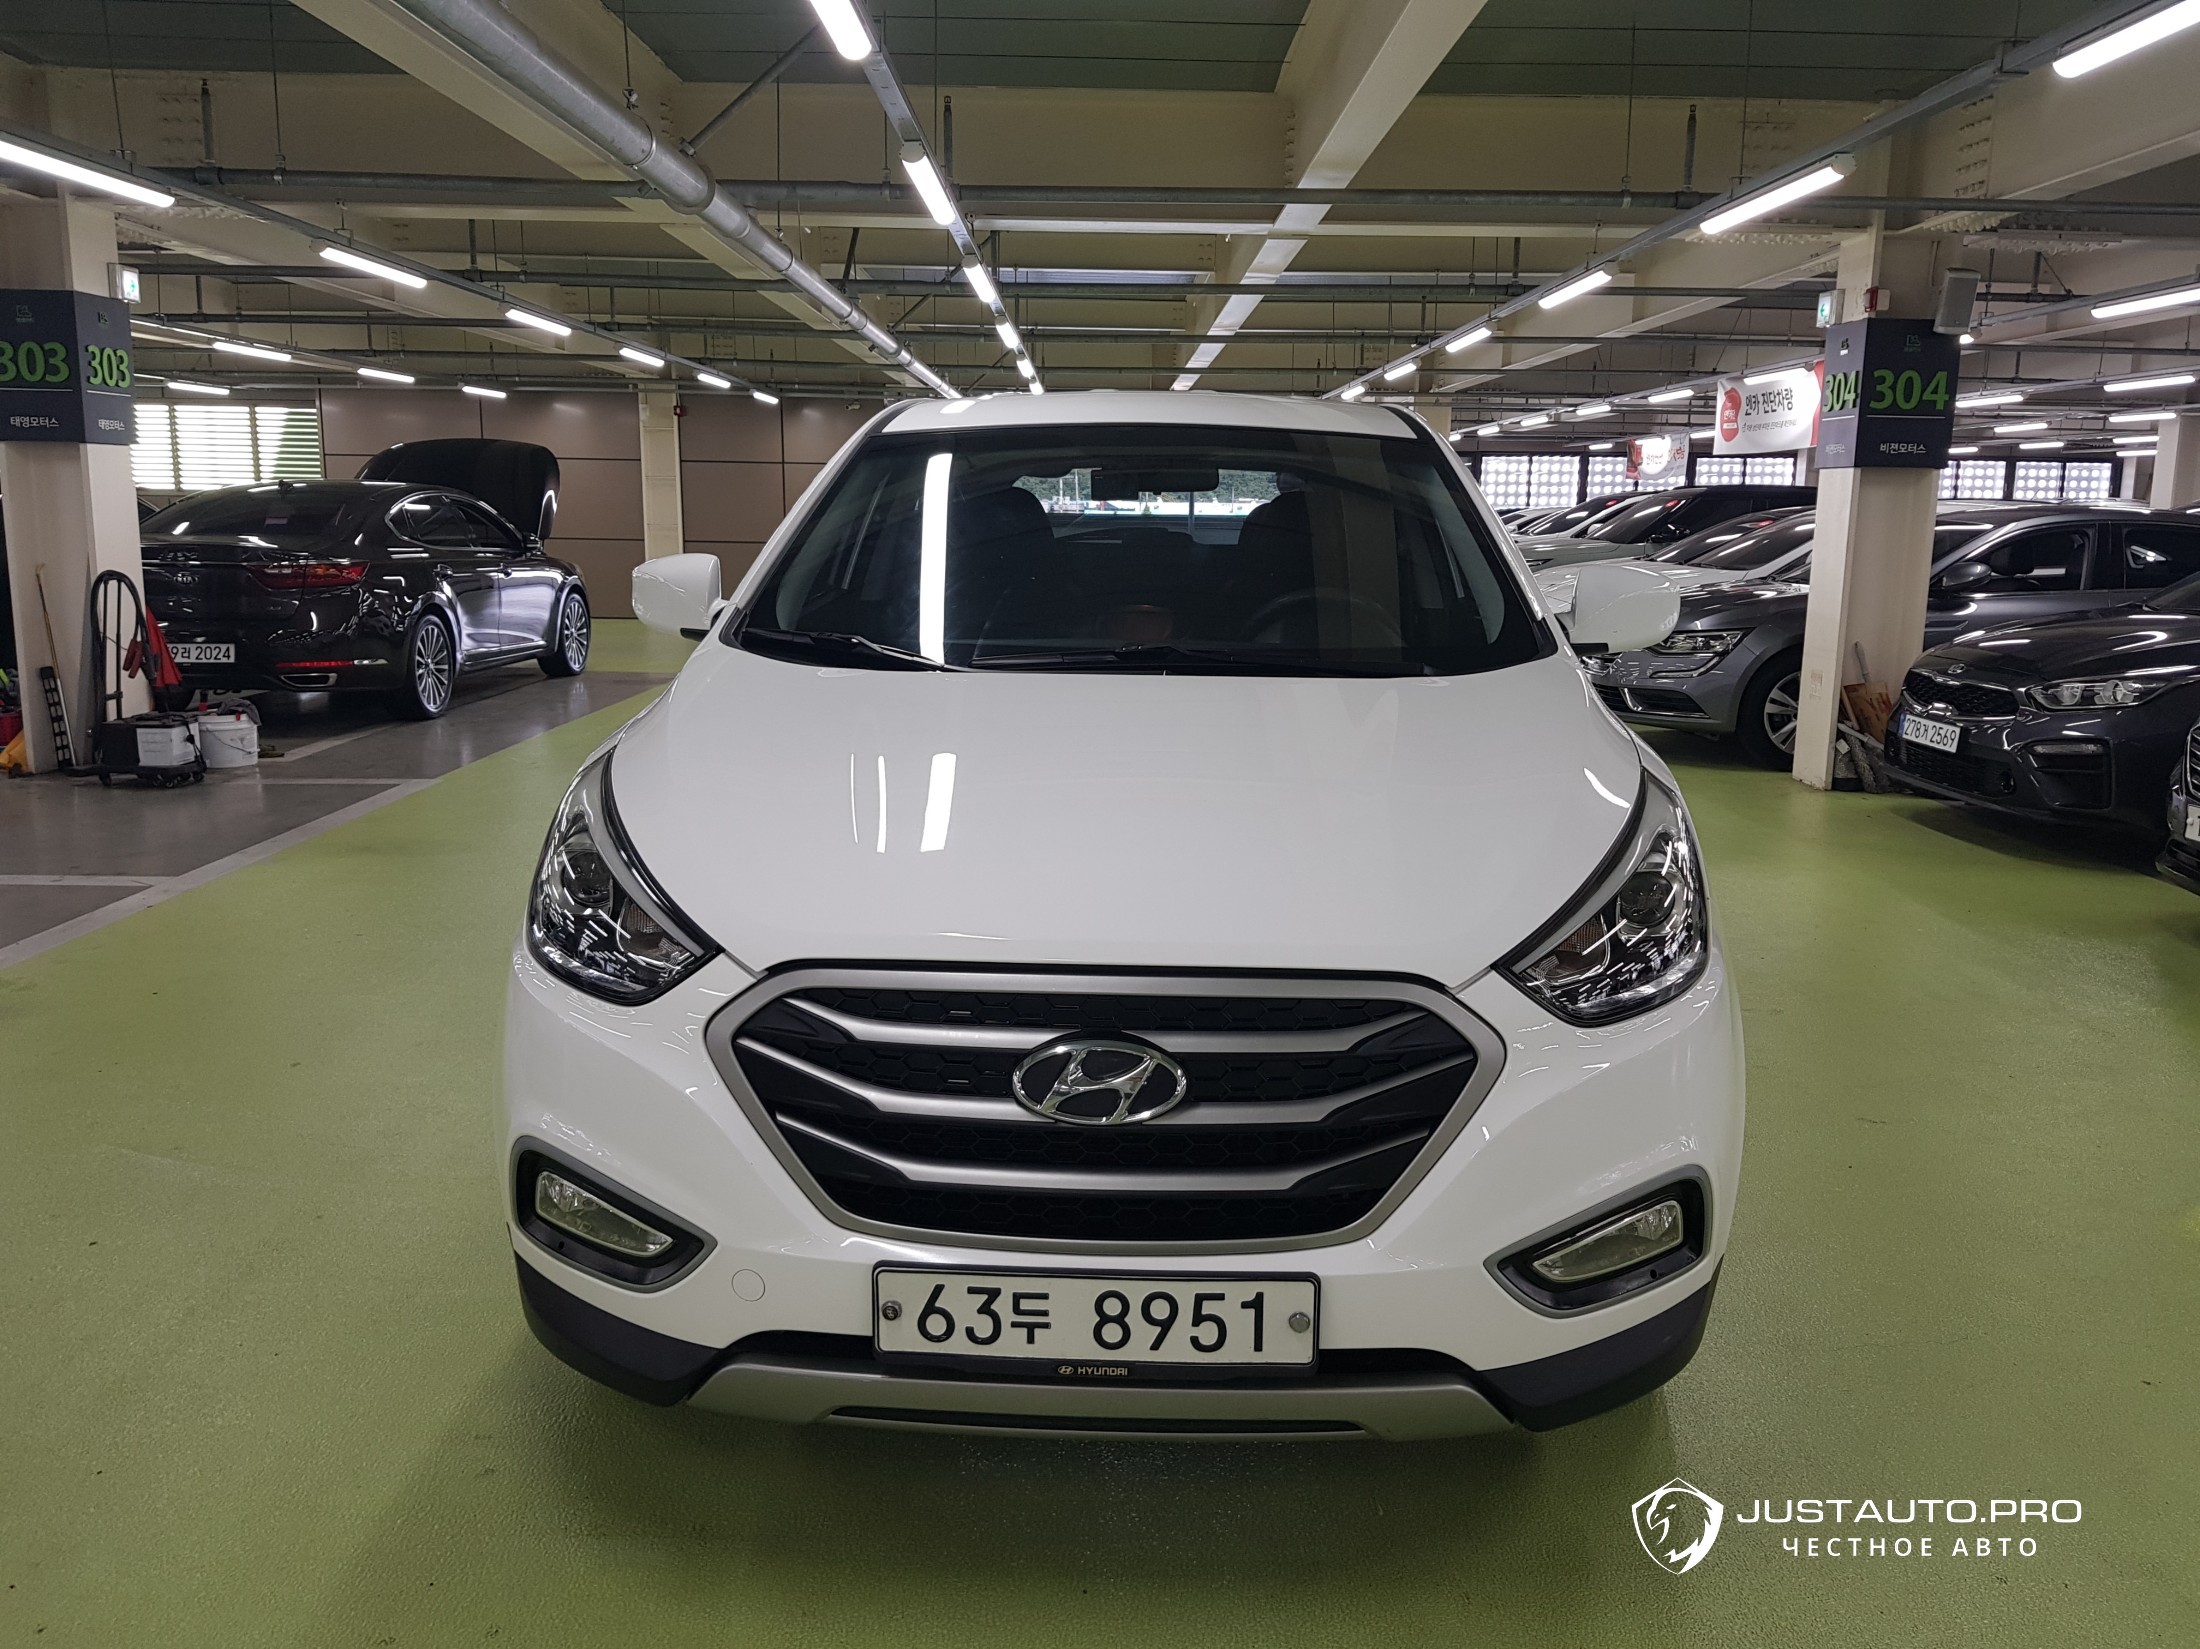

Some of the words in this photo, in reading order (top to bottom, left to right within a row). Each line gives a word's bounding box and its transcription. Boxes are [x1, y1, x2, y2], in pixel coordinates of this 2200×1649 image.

[0, 341, 70, 382] 303
[86, 345, 131, 388] 303
[1744, 393, 1760, 416] 엔카
[1761, 387, 1793, 414] 진단차량
[1822, 370, 1858, 412] 304
[1869, 368, 1949, 410] 304
[10, 416, 59, 428] 태영모터스
[98, 419, 126, 430] 태영모터스
[168, 645, 191, 661] 9러
[195, 646, 231, 661] 2024
[1904, 718, 1930, 741] 278거
[1930, 725, 1957, 748] 2569
[917, 1284, 1051, 1345] 63두
[1093, 1290, 1264, 1352] 8951
[1077, 1366, 1129, 1377] HYUNDAI
